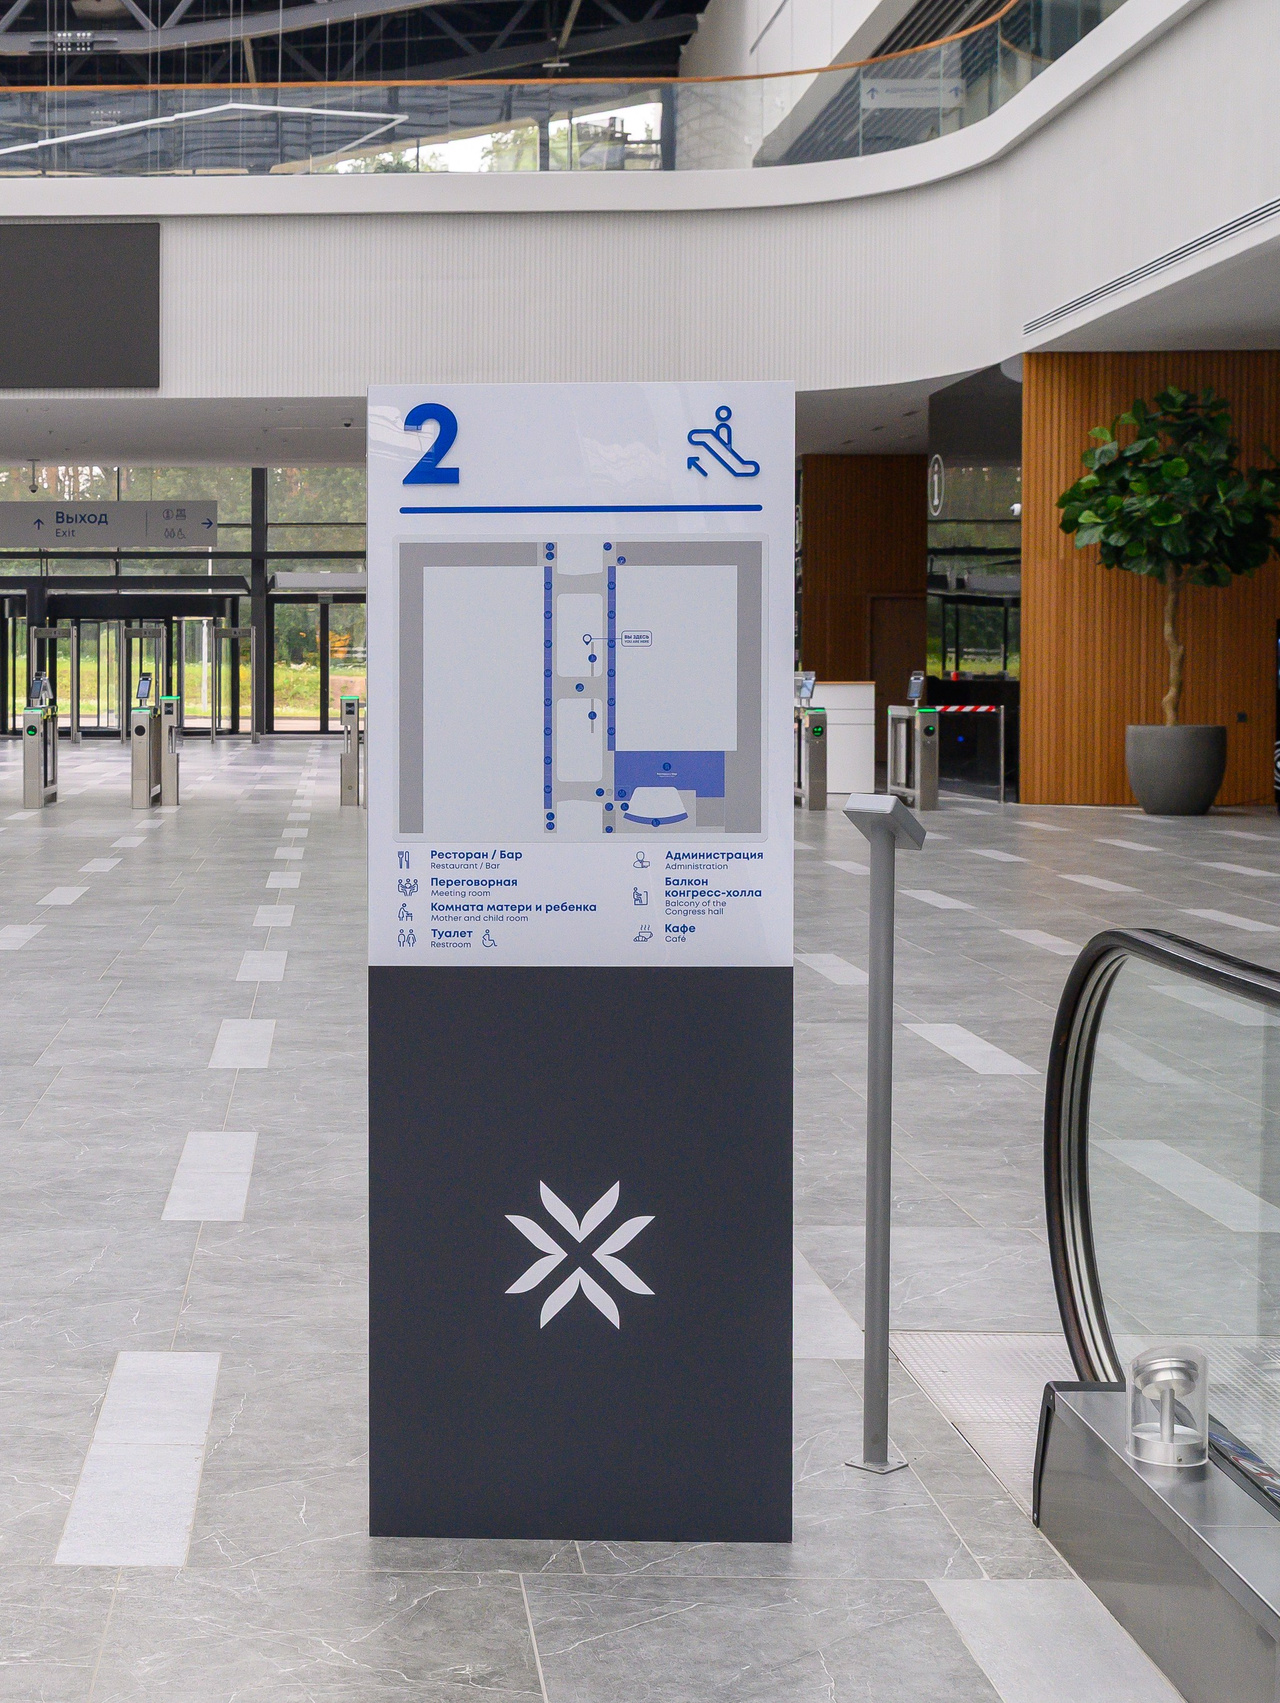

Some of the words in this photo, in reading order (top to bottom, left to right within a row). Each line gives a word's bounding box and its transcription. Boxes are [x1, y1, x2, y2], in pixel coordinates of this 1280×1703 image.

[401, 402, 460, 486] 2
[55, 510, 109, 527] Выход
[55, 528, 76, 538] Exit
[430, 850, 489, 861] Ресторан
[491, 849, 497, 861] /
[499, 849, 523, 861] Бар
[665, 850, 764, 862] Администрация
[430, 861, 478, 870] Restaurant
[485, 861, 501, 870] Bar
[665, 862, 729, 871] Administration
[430, 877, 518, 889] Переговорная
[664, 876, 709, 887] Балкон
[430, 889, 467, 899] Meeting
[468, 890, 491, 898] room
[664, 888, 762, 899] конгресс-холла
[430, 902, 484, 912] Комната
[486, 903, 532, 914] матери
[535, 904, 543, 912] и
[545, 901, 597, 914] ребенка
[664, 899, 700, 909] Balcony
[701, 899, 711, 908] of
[712, 899, 727, 908] the
[664, 907, 706, 916] Congress
[707, 907, 724, 916] hall
[430, 914, 463, 922] Mother
[463, 914, 481, 922] and
[482, 914, 504, 922] child
[431, 928, 473, 939] Туалет
[664, 923, 697, 935] Кафе
[430, 940, 472, 948] Restroom
[664, 934, 687, 943] Café
